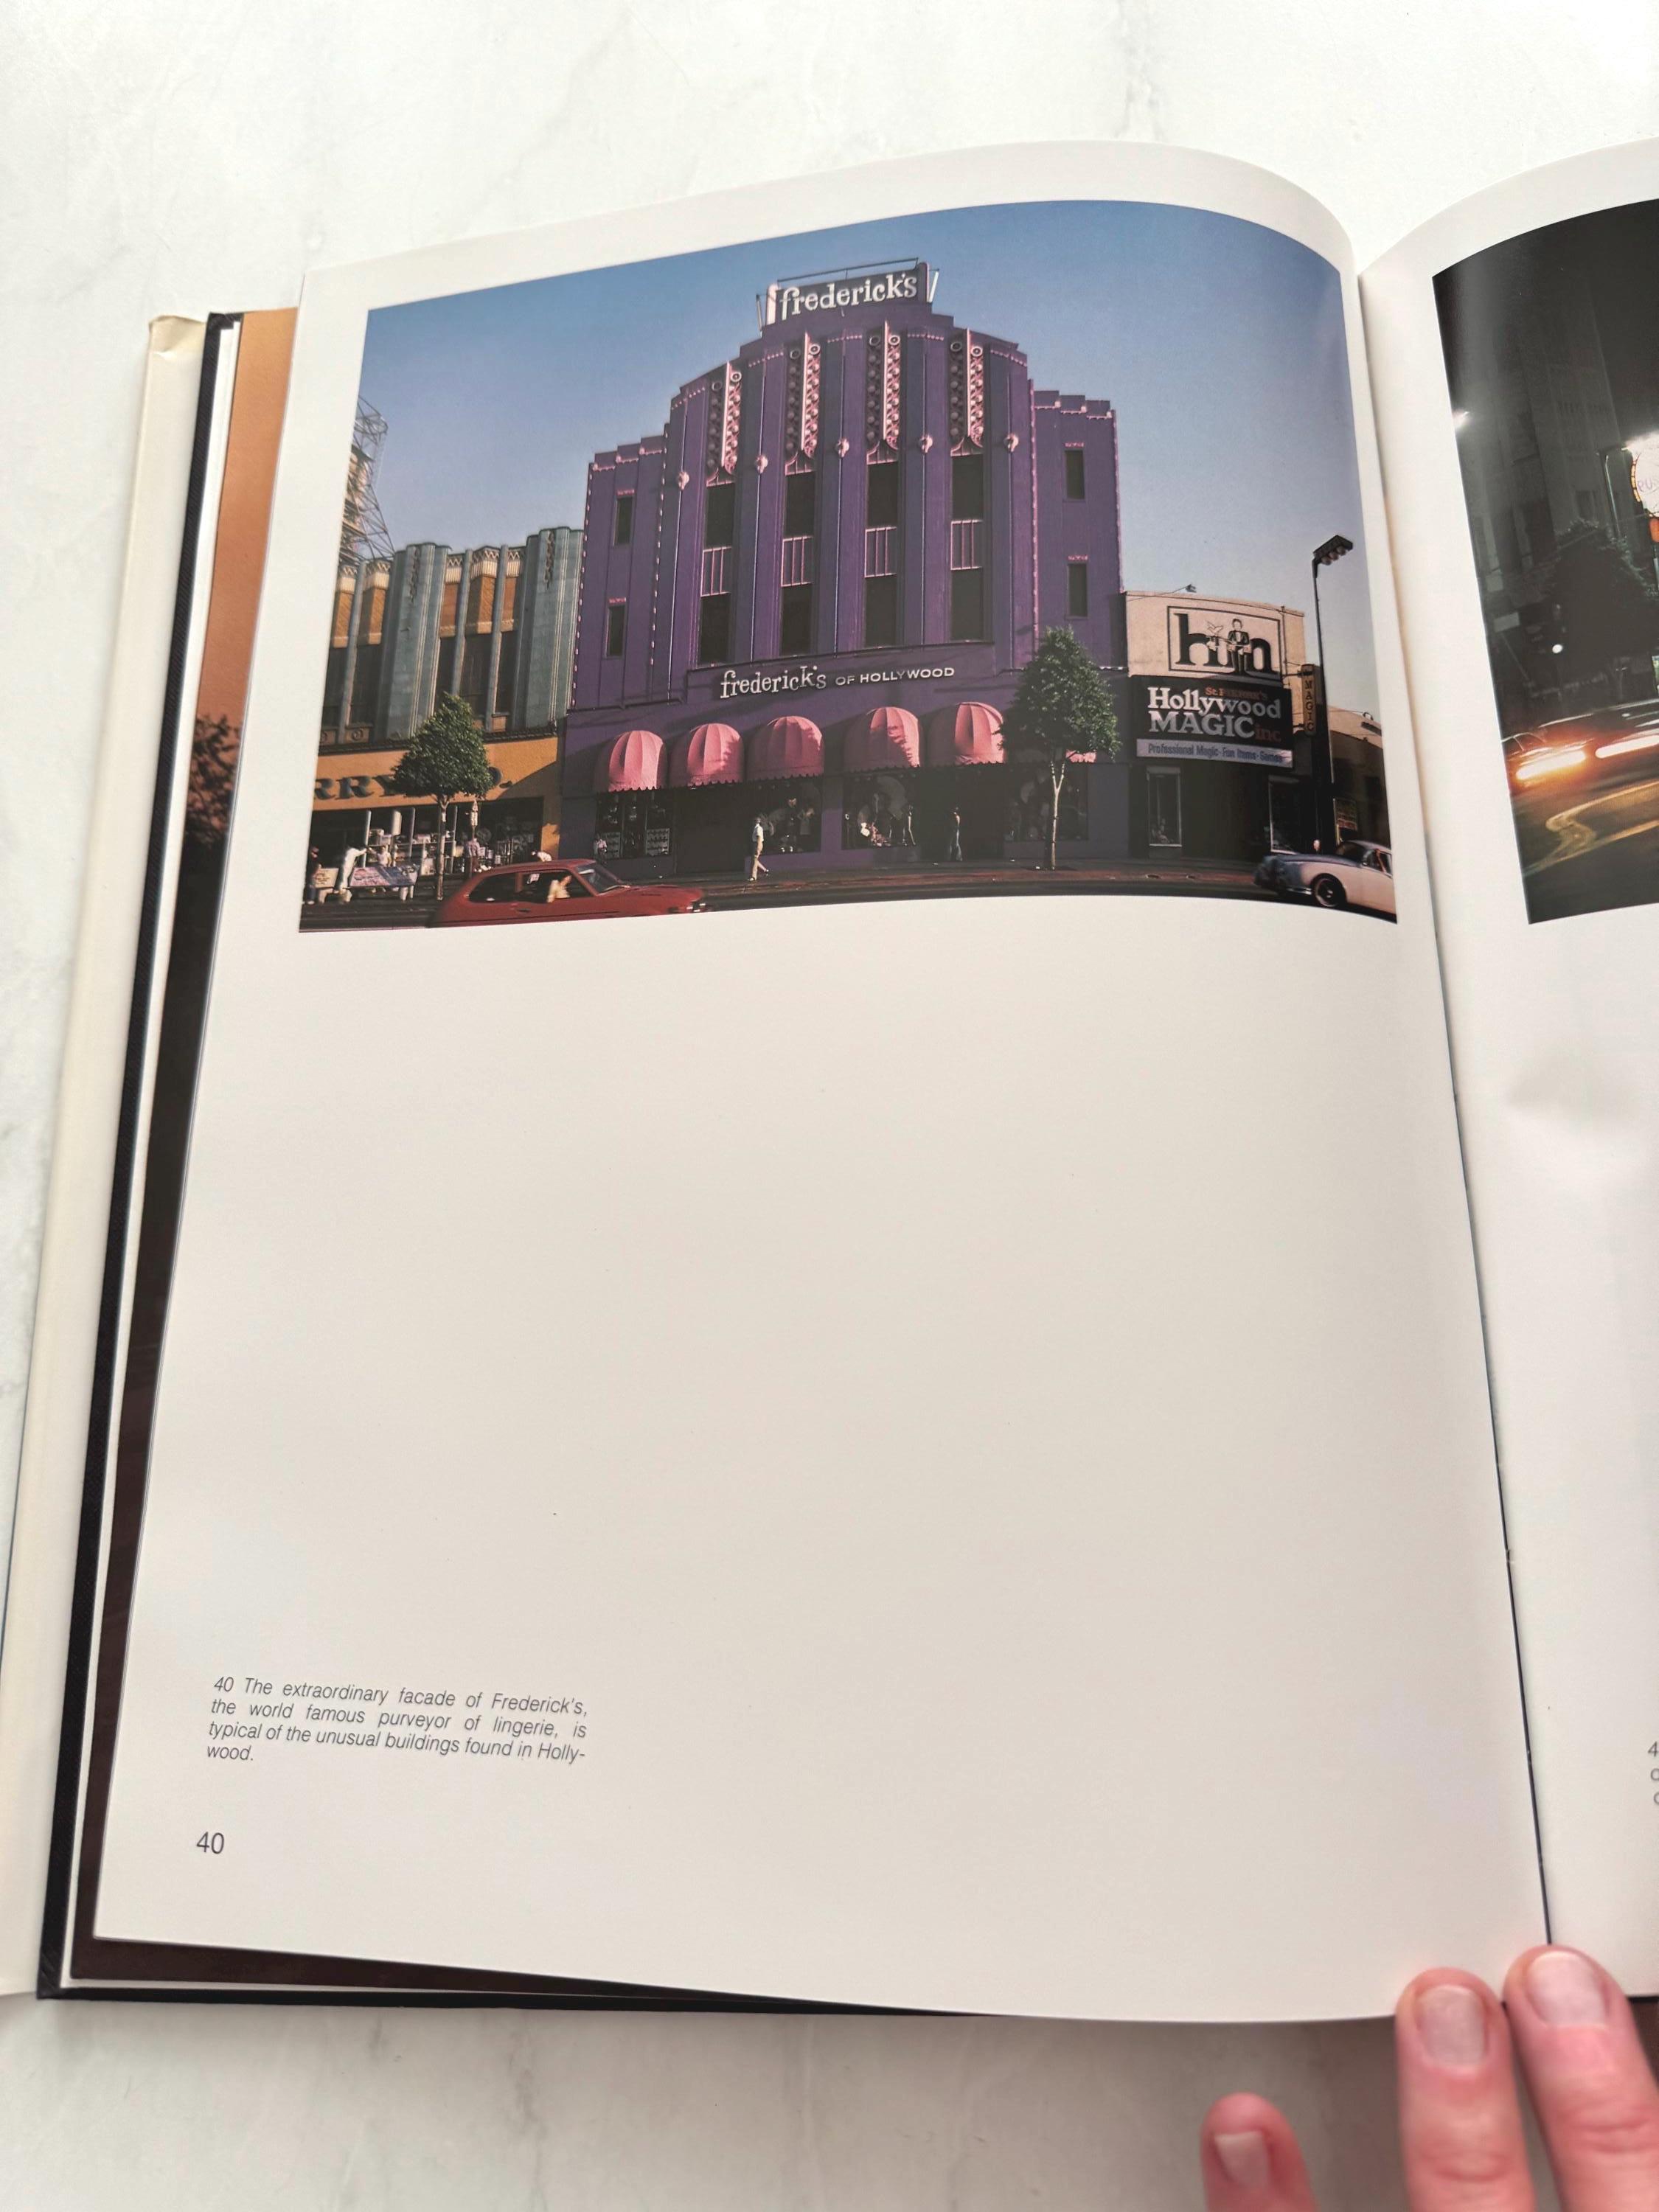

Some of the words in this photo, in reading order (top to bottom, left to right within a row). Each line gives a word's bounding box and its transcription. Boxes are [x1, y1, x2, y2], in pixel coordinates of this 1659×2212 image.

[779, 272, 917, 321] frederick's
[720, 666, 826, 698] frederick's
[835, 675, 855, 686] OF
[860, 667, 955, 684] HOLLYWOOD
[1147, 686, 1282, 719] Hollywood
[1304, 679, 1314, 731] MAGIC
[1148, 710, 1255, 738] MAGIC
[1148, 742, 1194, 755] Professional
[214, 1676, 234, 1692] 40
[244, 1677, 273, 1695] The
[282, 1683, 389, 1705] extraordinary
[398, 1687, 456, 1706] facade
[465, 1691, 484, 1708] of
[491, 1692, 588, 1717] Frederick's,
[211, 1699, 237, 1715] the
[249, 1703, 295, 1719] world
[305, 1705, 366, 1723] famous
[378, 1711, 451, 1732] purveyor
[464, 1714, 481, 1731] of
[493, 1716, 559, 1739] lingerie,
[572, 1720, 588, 1739] is
[206, 1745, 254, 1761] wood.
[209, 1721, 262, 1740] typical
[266, 1724, 285, 1741] of
[286, 1726, 312, 1743] the
[316, 1731, 382, 1747] unusual
[385, 1733, 460, 1756] buildings
[465, 1736, 513, 1756] found
[518, 1740, 532, 1758] in
[538, 1742, 586, 1765] Holly-
[195, 1831, 225, 1855] 40
